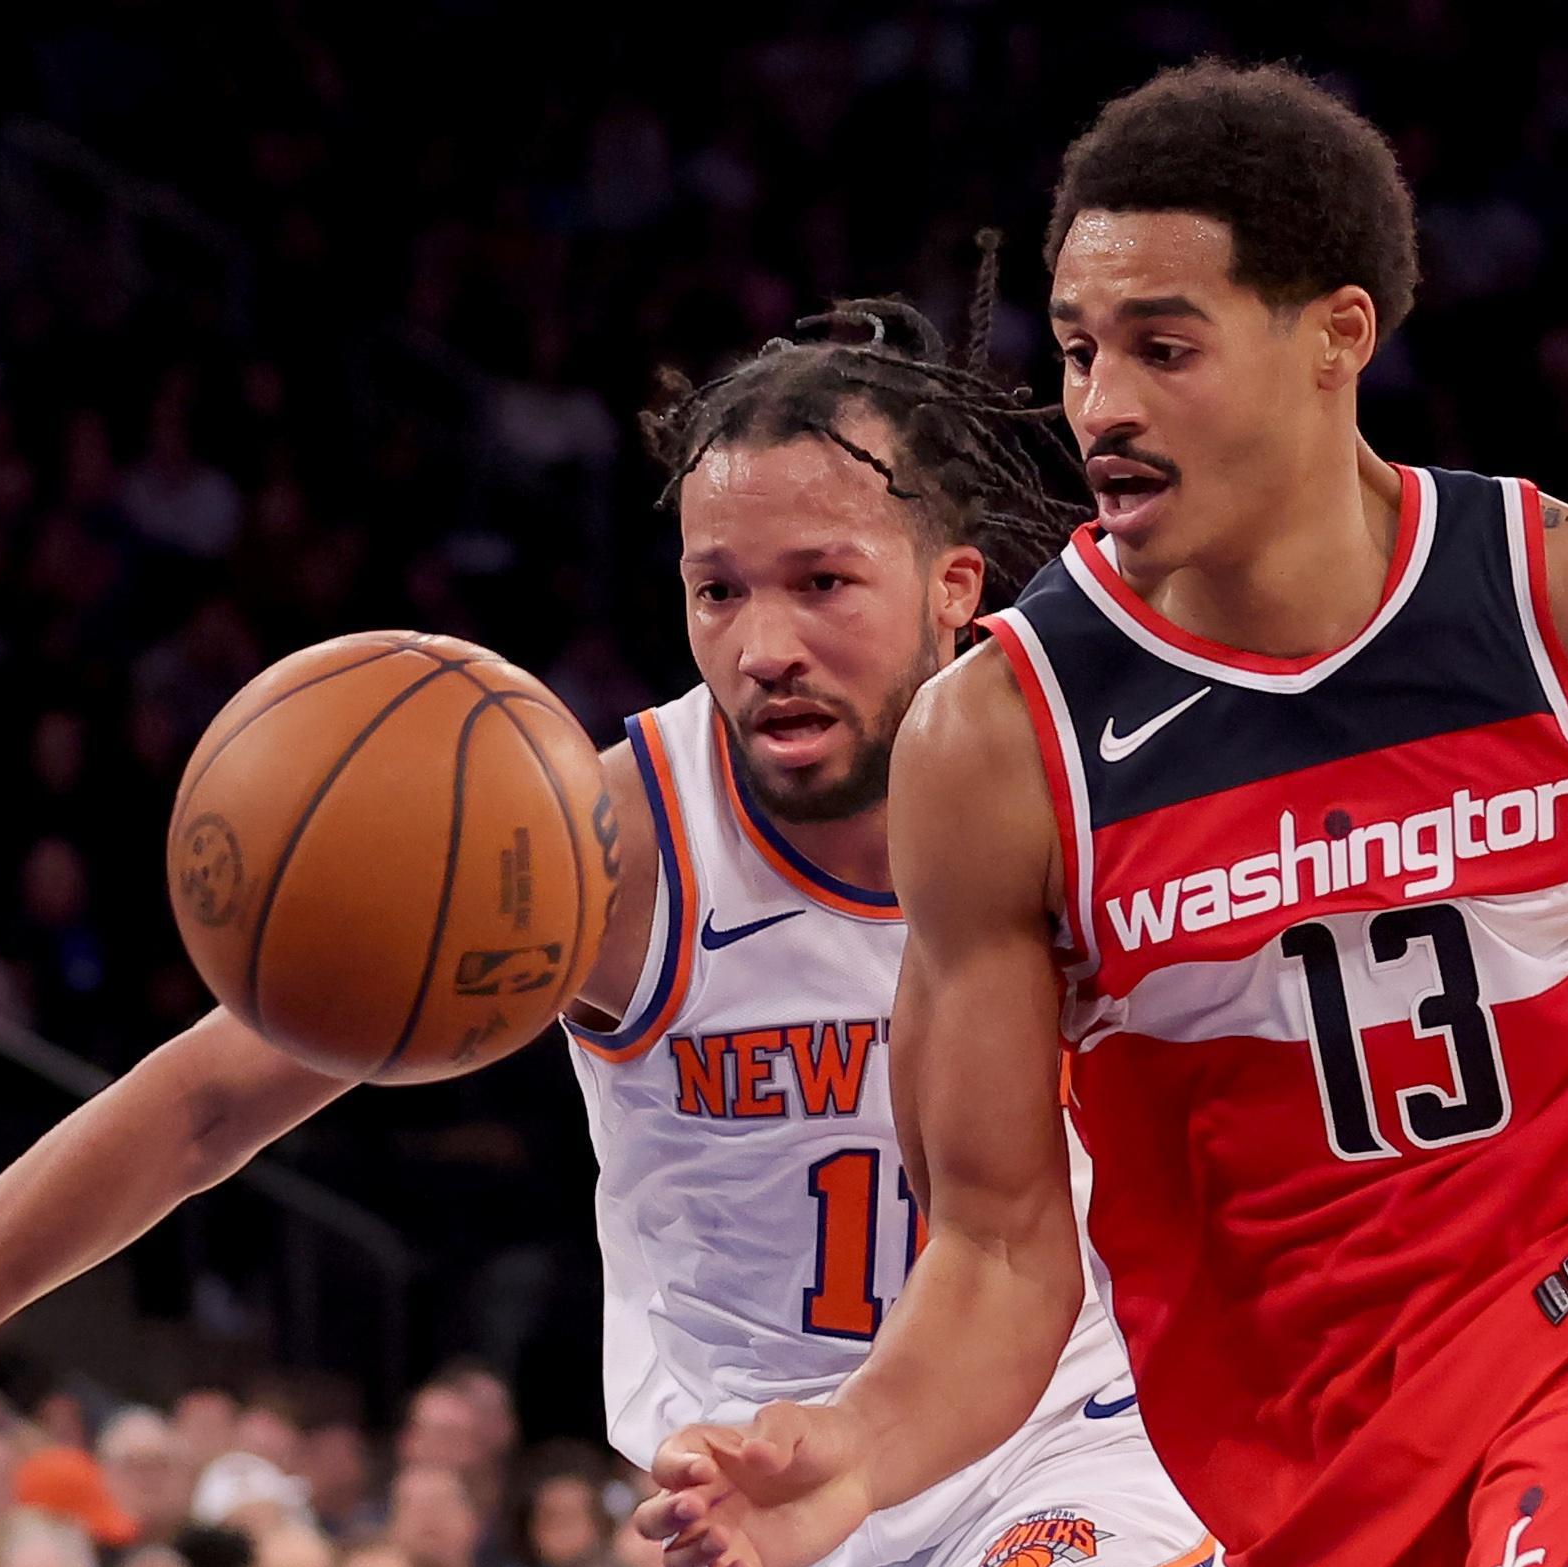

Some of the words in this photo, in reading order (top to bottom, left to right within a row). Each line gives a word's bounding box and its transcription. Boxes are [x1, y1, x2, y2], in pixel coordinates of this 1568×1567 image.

[667, 1017, 877, 1120] NEW
[1281, 902, 1512, 1161] 13
[802, 1147, 931, 1341] 1
